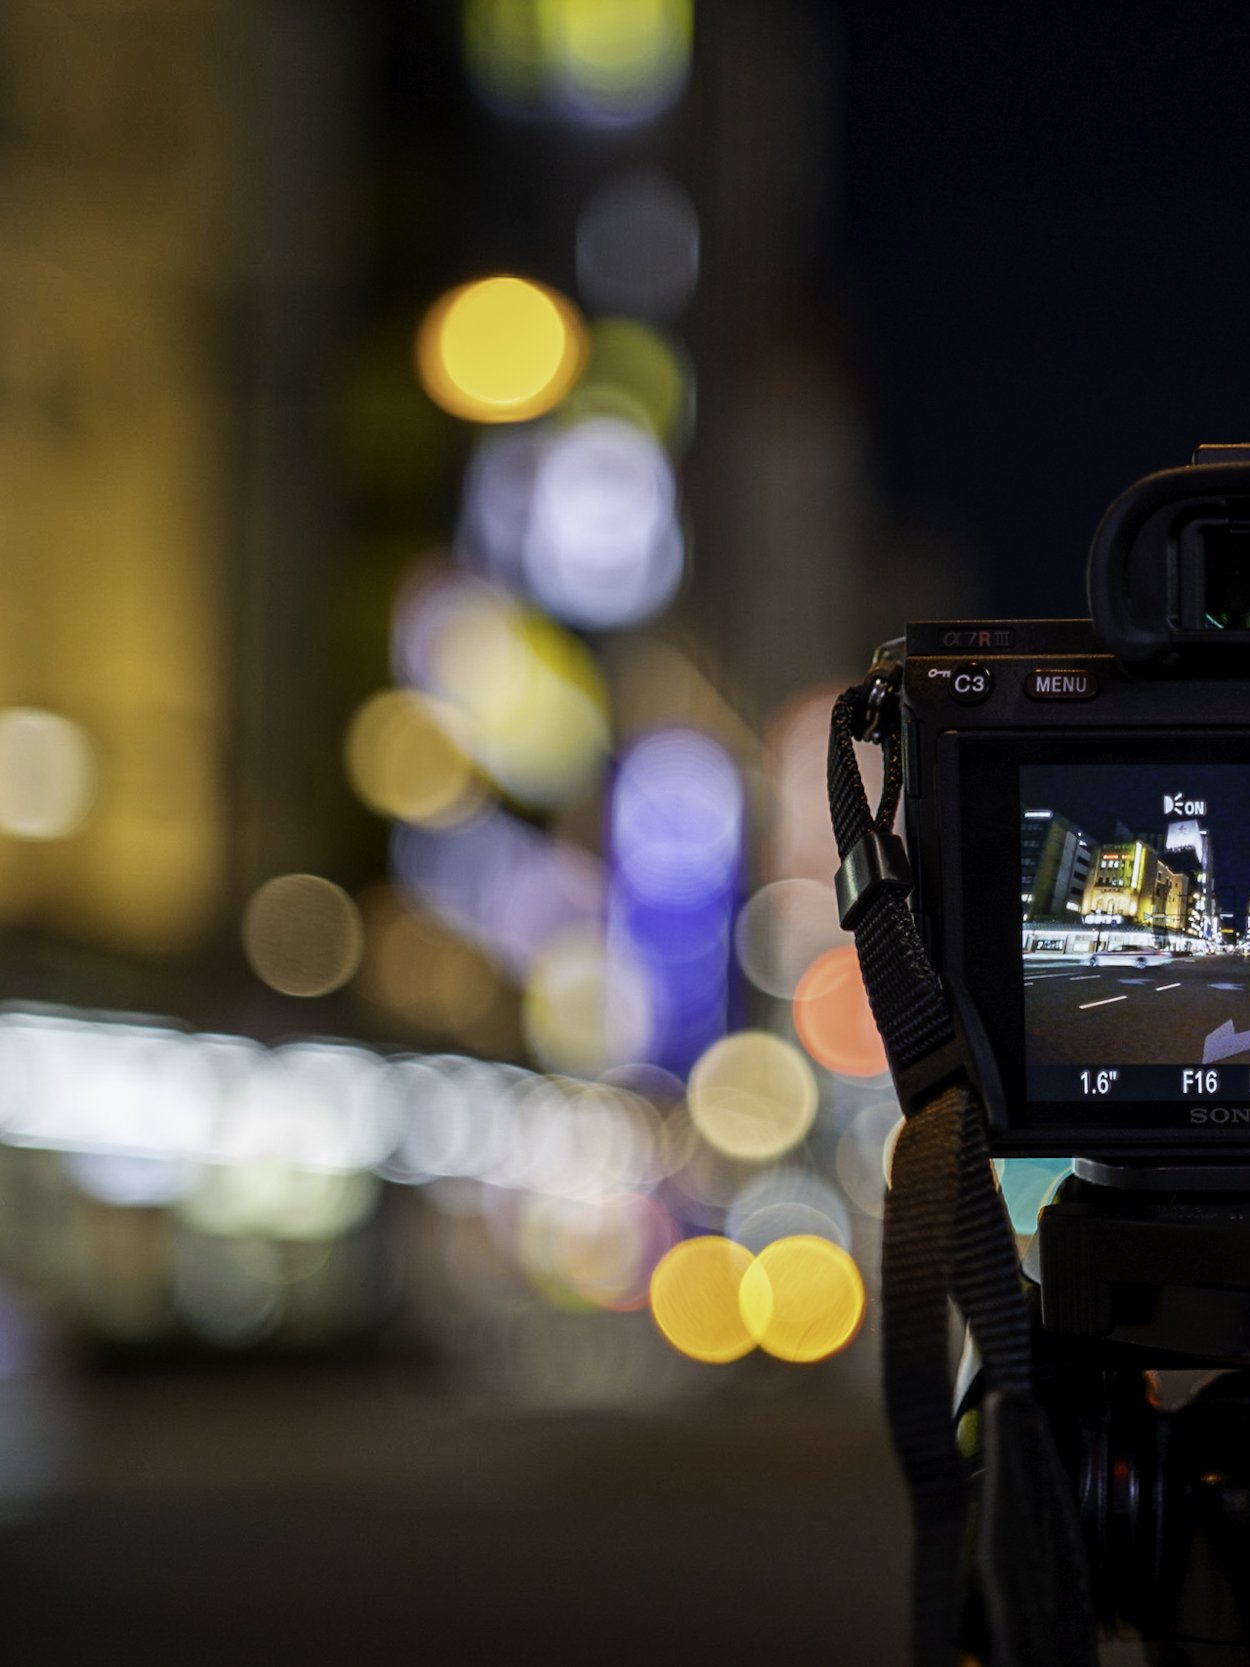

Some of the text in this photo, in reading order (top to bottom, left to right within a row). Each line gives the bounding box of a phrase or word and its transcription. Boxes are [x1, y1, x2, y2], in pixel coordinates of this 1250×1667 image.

[954, 674, 985, 693] C3
[1036, 676, 1087, 693] MENU
[1080, 1071, 1118, 1094] 1.6"
[1183, 1071, 1218, 1094] F16
